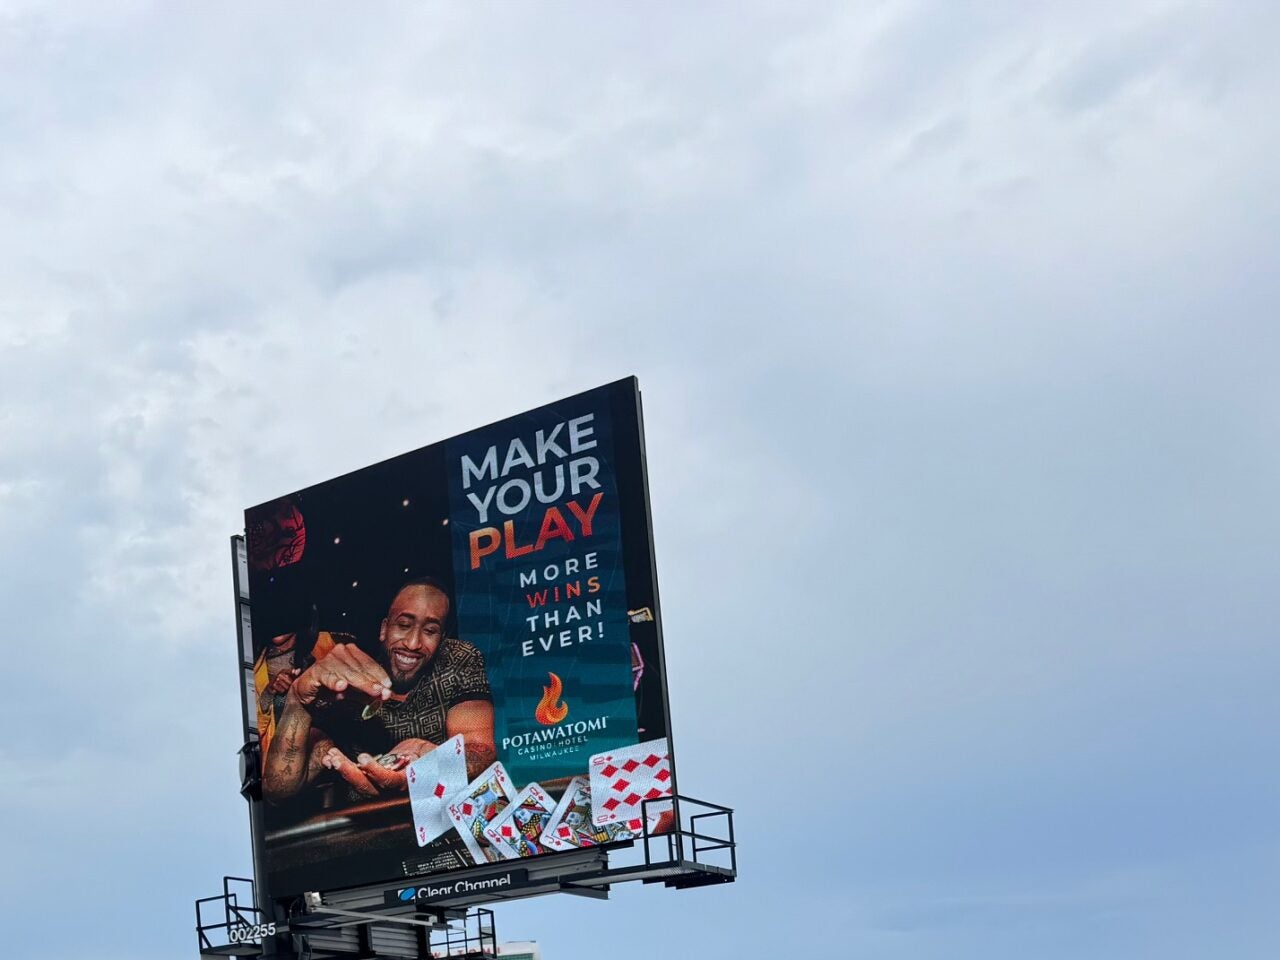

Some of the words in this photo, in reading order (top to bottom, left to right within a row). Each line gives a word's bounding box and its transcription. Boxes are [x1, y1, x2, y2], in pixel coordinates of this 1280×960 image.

[461, 413, 597, 489] MAKE
[466, 456, 602, 524] YOUR
[469, 492, 604, 570] PLAY
[520, 552, 599, 588] MORE
[527, 576, 601, 608] WINS
[526, 599, 602, 632] THAN
[522, 622, 605, 657] EVER!
[502, 716, 608, 750] POTAWATOMI
[517, 742, 552, 755] CASINO
[558, 735, 588, 748] HOTEL
[529, 745, 579, 760] MILWAUKEE
[417, 886, 453, 899] Clear
[455, 874, 511, 893] Channel
[230, 922, 276, 943] 002255
